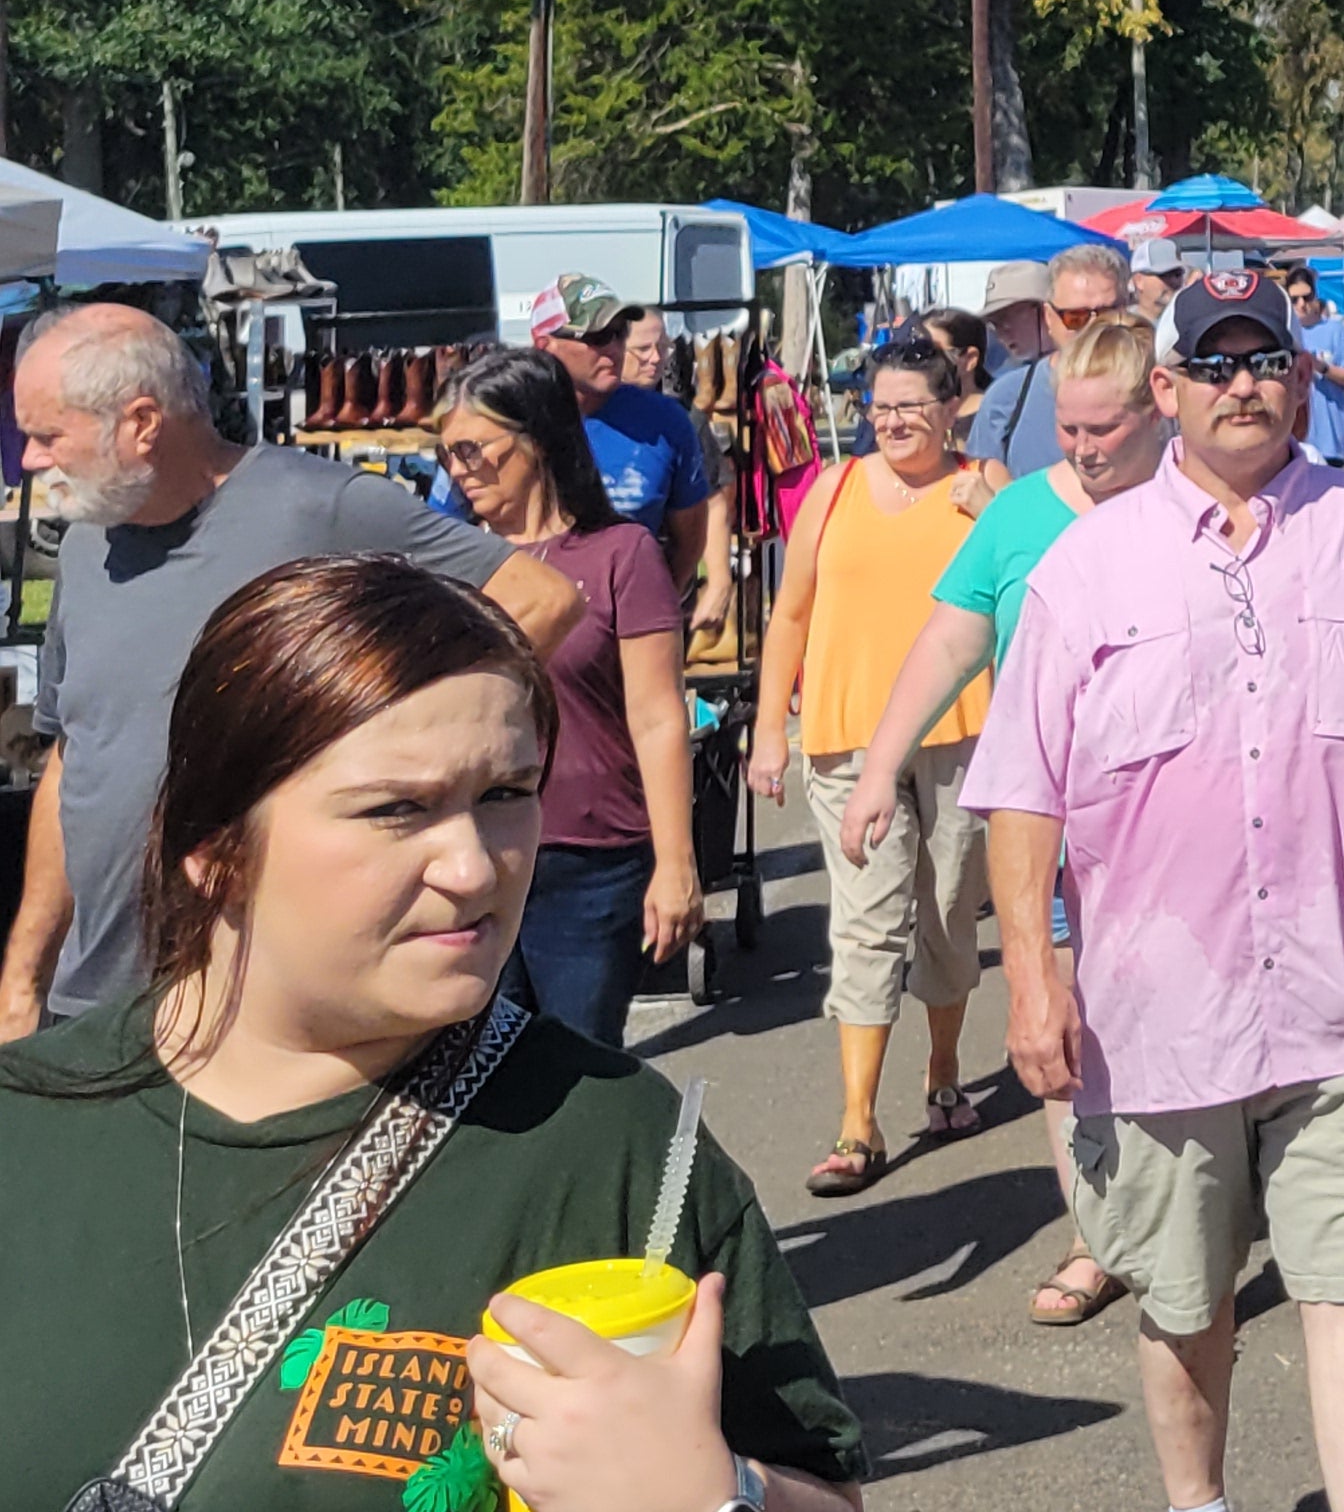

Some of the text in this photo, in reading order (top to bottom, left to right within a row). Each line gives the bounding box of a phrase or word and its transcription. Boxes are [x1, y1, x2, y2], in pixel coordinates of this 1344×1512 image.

[341, 1350, 470, 1390] ISLAND
[329, 1383, 441, 1420] STATE
[336, 1415, 442, 1456] MIND
